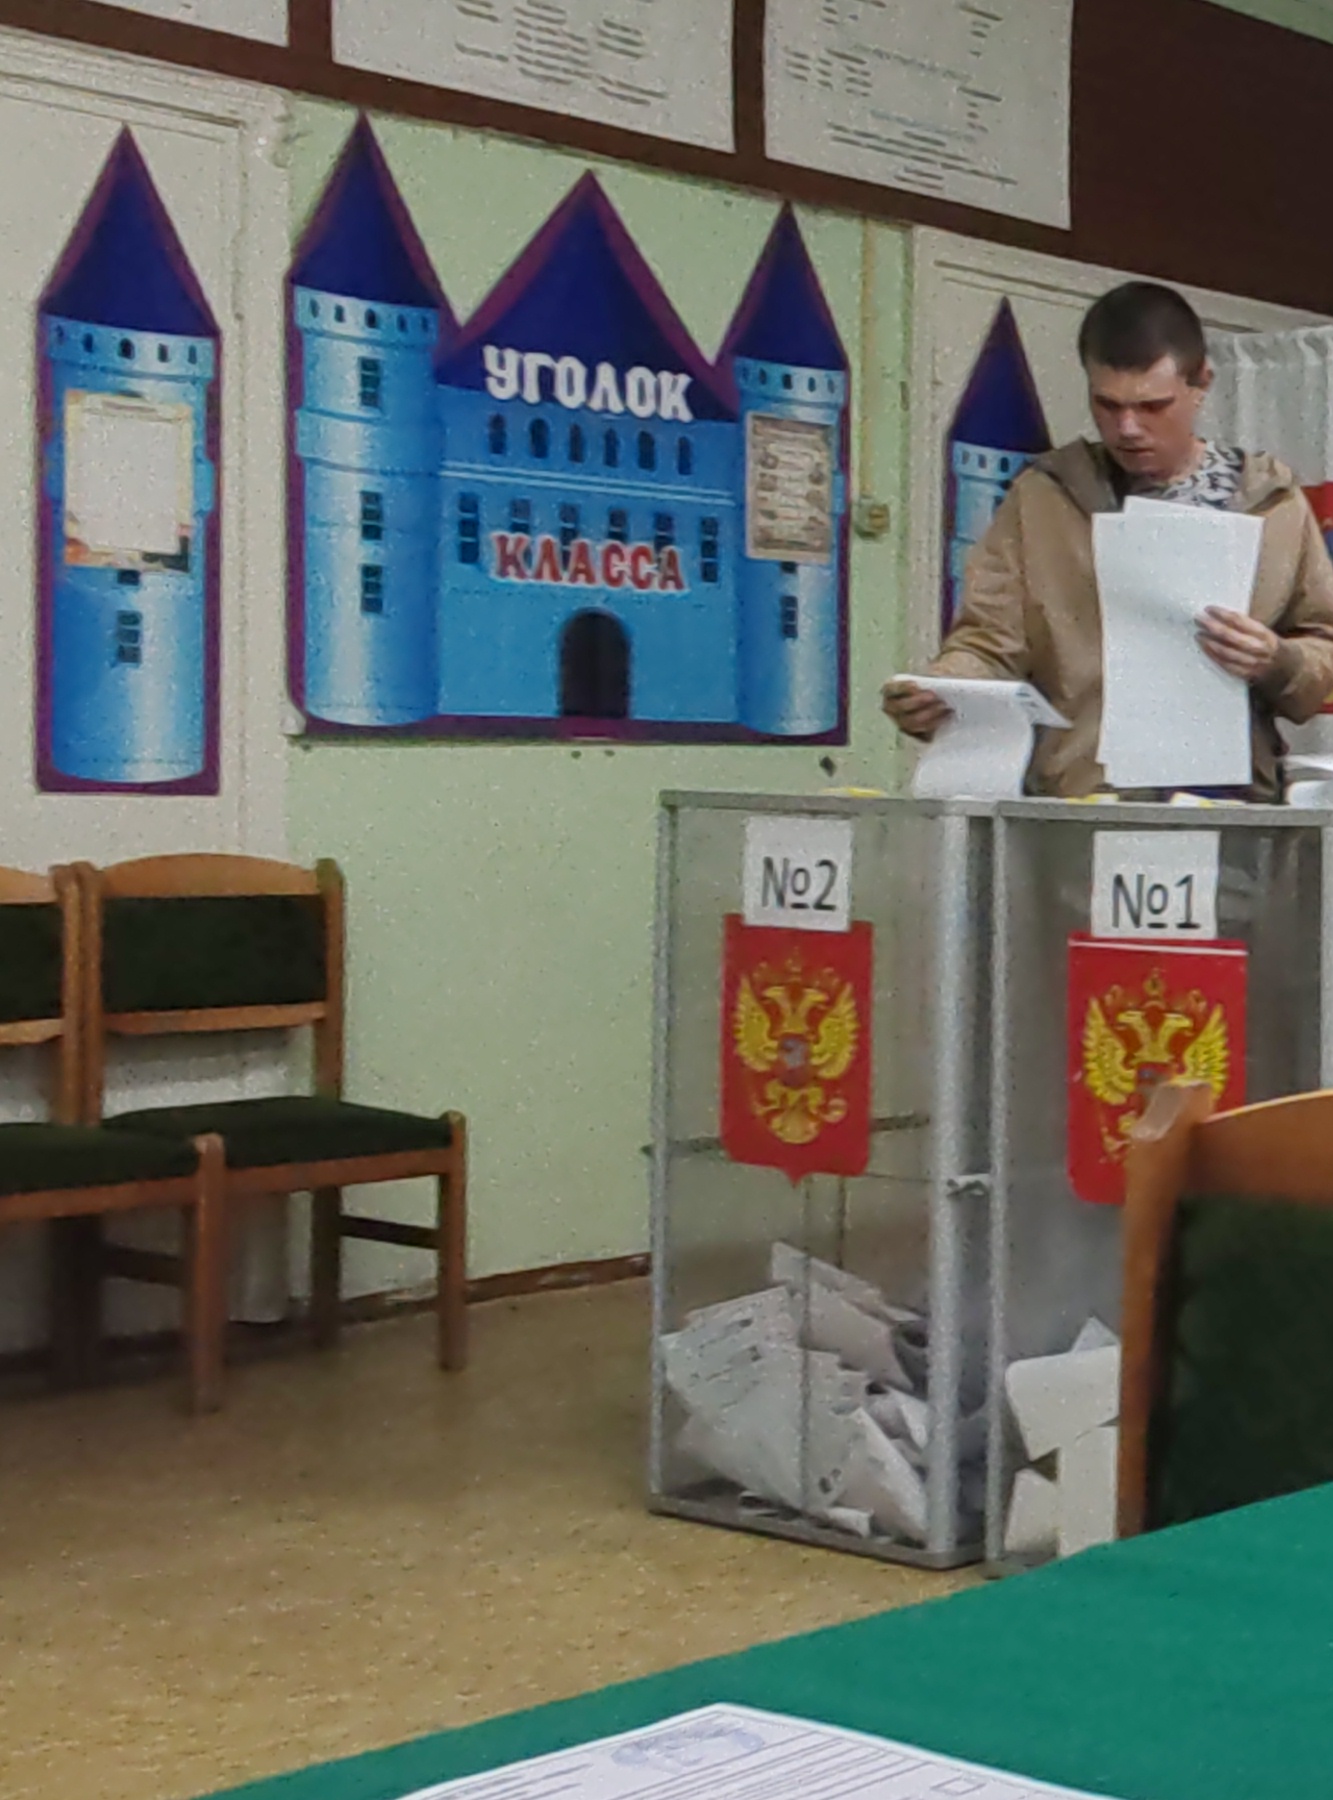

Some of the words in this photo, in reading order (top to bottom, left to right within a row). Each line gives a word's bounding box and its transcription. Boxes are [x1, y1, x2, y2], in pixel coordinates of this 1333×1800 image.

[483, 344, 694, 424] УГОЛОК
[491, 532, 688, 593] КЛАССА
[762, 856, 838, 911] №2
[1111, 873, 1202, 930] №1
